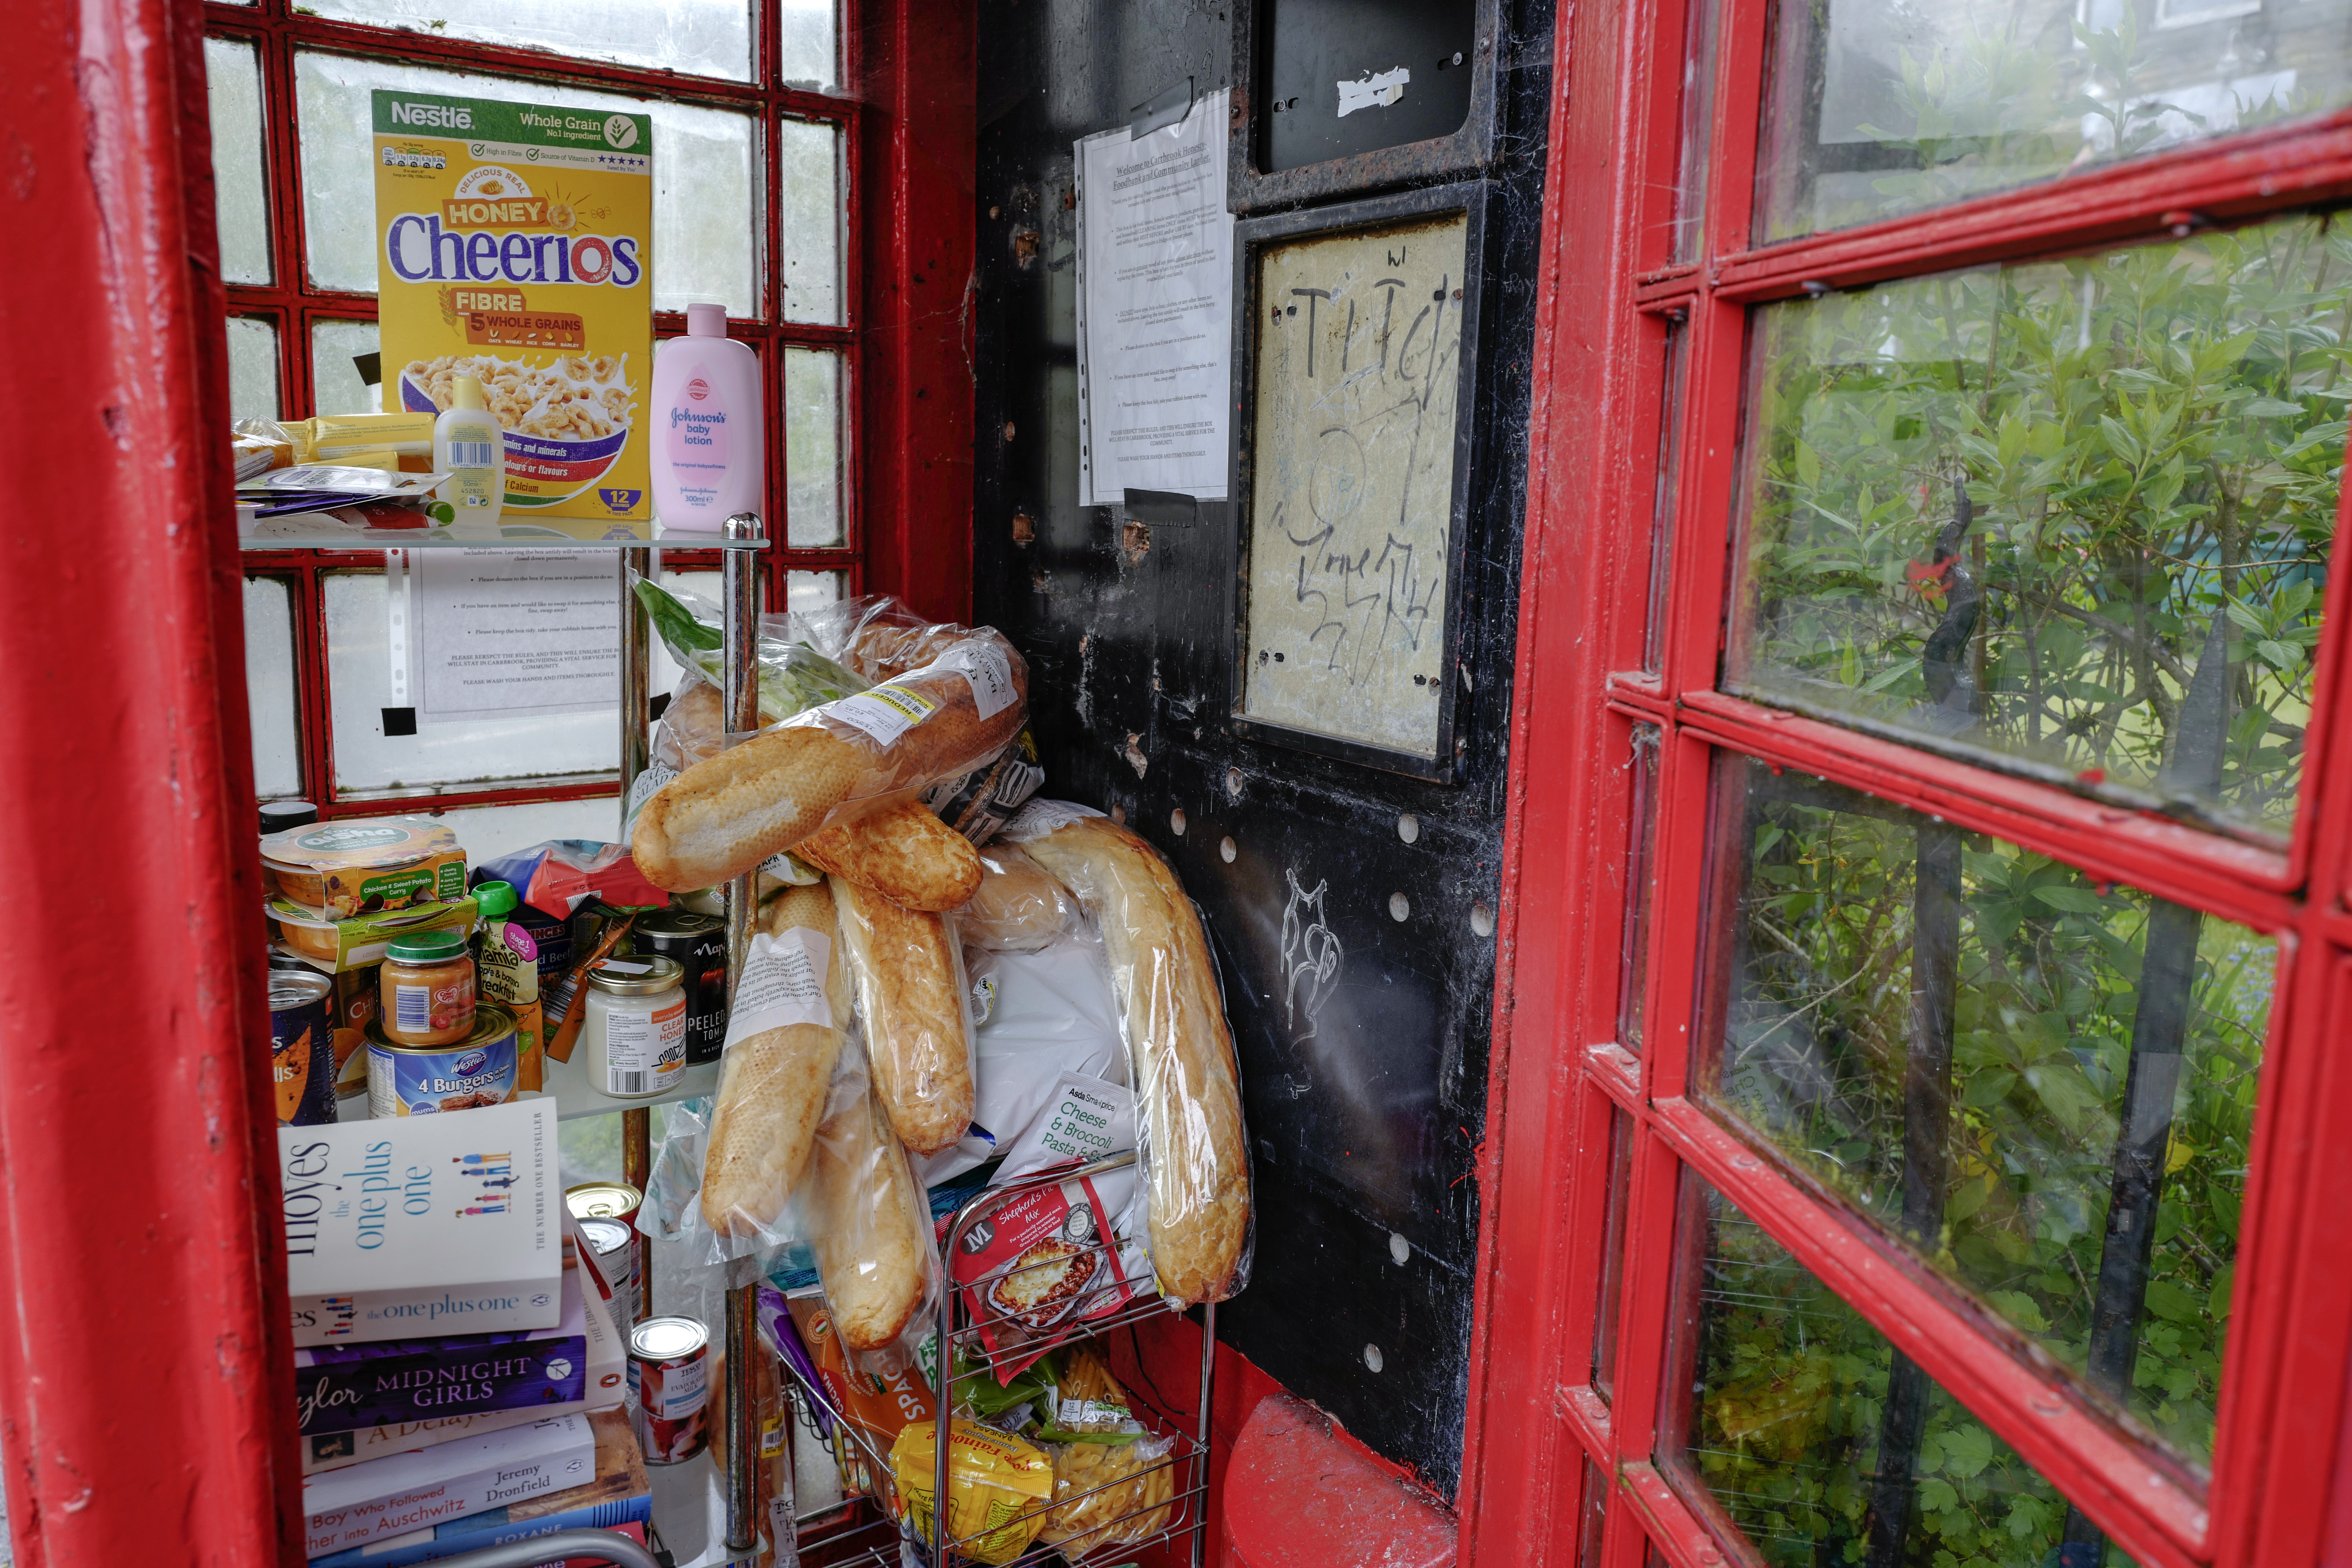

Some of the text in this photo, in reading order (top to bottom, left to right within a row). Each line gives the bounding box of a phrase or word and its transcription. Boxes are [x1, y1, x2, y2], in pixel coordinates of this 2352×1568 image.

[519, 113, 601, 131] Whole Grain
[564, 132, 601, 140] ingredient
[1113, 154, 1210, 189] Foodbank and Community Larder.
[1117, 162, 1143, 175] Welcome
[1151, 149, 1181, 165] Carrbrook
[460, 169, 526, 194] DELICIOUS REAL
[449, 202, 542, 223] HONEY
[389, 216, 639, 285] Cheerios
[456, 292, 523, 312] FIBRE
[471, 312, 581, 331] 5 WHOLE GRAINS
[671, 407, 726, 428] Johnson's
[685, 435, 712, 445] lotion
[687, 424, 710, 435] baby
[523, 443, 567, 457] and minerals
[538, 464, 568, 476] flavours
[510, 482, 539, 493] Calcium
[610, 491, 629, 503] 12
[872, 693, 912, 715] REDUCED
[847, 717, 876, 731] TESCO
[635, 775, 668, 802] SALAD
[305, 829, 397, 845] aisha
[510, 932, 524, 946] Stage
[654, 1013, 674, 1021] everyday
[662, 1016, 683, 1032] CLEAR
[688, 1009, 725, 1031] PEELED
[660, 1025, 684, 1042] HONEY
[451, 1054, 487, 1074] Westlers
[419, 1071, 494, 1094] 4 Burgers
[495, 1071, 506, 1080] Gravy
[1069, 1088, 1085, 1100] Asda
[1061, 1102, 1107, 1129] Cheese
[534, 1112, 542, 1169] BESTSELLER
[1051, 1117, 1114, 1149] & Broccoli
[1042, 1132, 1076, 1156] Pasta
[1077, 1147, 1087, 1157] &
[343, 1142, 401, 1193] plus
[403, 1166, 432, 1215] one
[330, 1200, 350, 1218] the
[999, 1192, 1041, 1225] Shepherd's
[1025, 1209, 1040, 1223] Mix
[356, 1198, 388, 1250] one
[1020, 1222, 1036, 1237] perfectly
[1036, 1212, 1051, 1226] seasoned
[1021, 1229, 1037, 1243] prepared
[1041, 1216, 1056, 1227] minutes
[1039, 1227, 1048, 1236] lamb
[536, 1230, 544, 1250] THE
[964, 1222, 992, 1251] M
[1064, 1230, 1074, 1242] QUICK
[367, 1294, 519, 1319] the one plus one
[376, 1357, 531, 1392] MIDNIGHT
[681, 1363, 700, 1375] TESCO
[413, 1381, 493, 1407] GIRLS
[495, 1465, 541, 1486] Jeremy
[486, 1475, 550, 1502] Dronfield
[313, 1486, 445, 1529] Boy Who Followed
[344, 1499, 466, 1541] into Auschwitz
